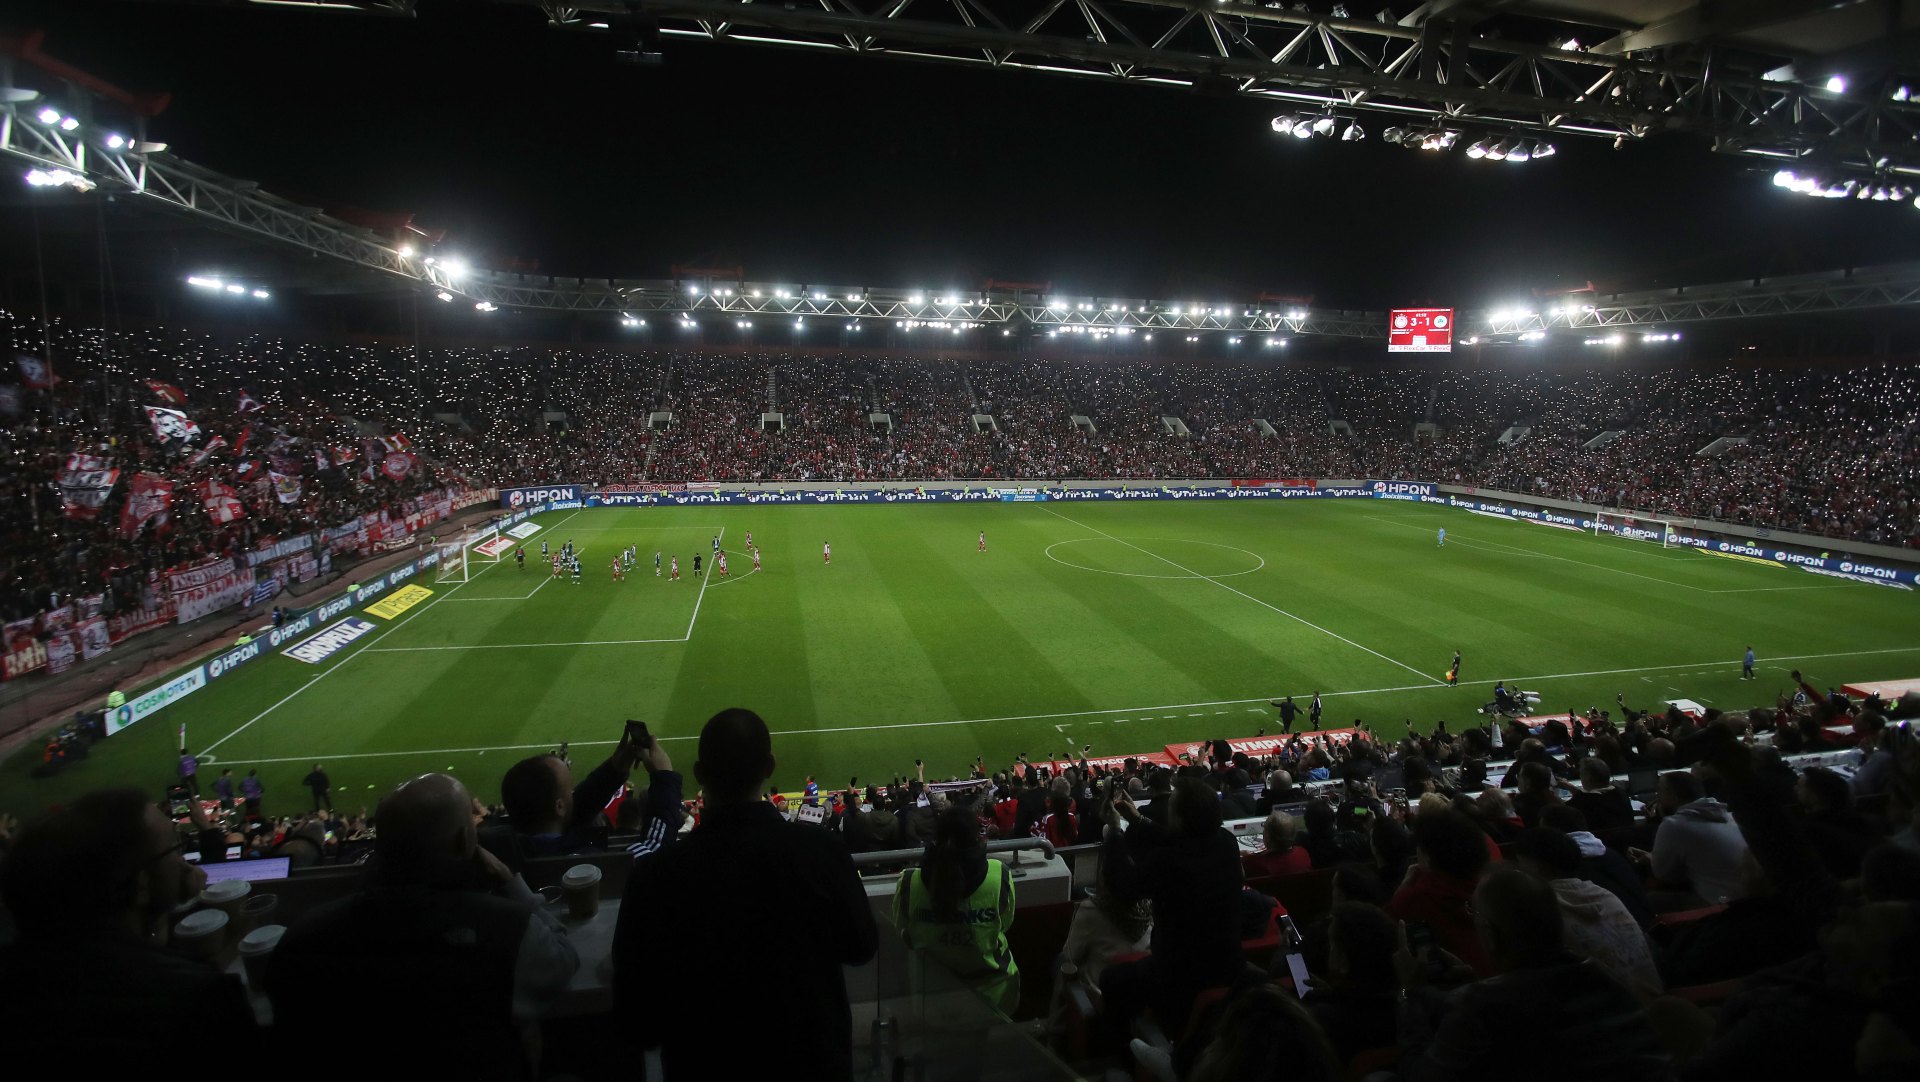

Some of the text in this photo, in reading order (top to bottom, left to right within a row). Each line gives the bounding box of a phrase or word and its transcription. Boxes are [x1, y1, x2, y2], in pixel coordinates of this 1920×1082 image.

[1410, 317, 1417, 327] 3
[135, 675, 198, 714] COSMOTE TV
